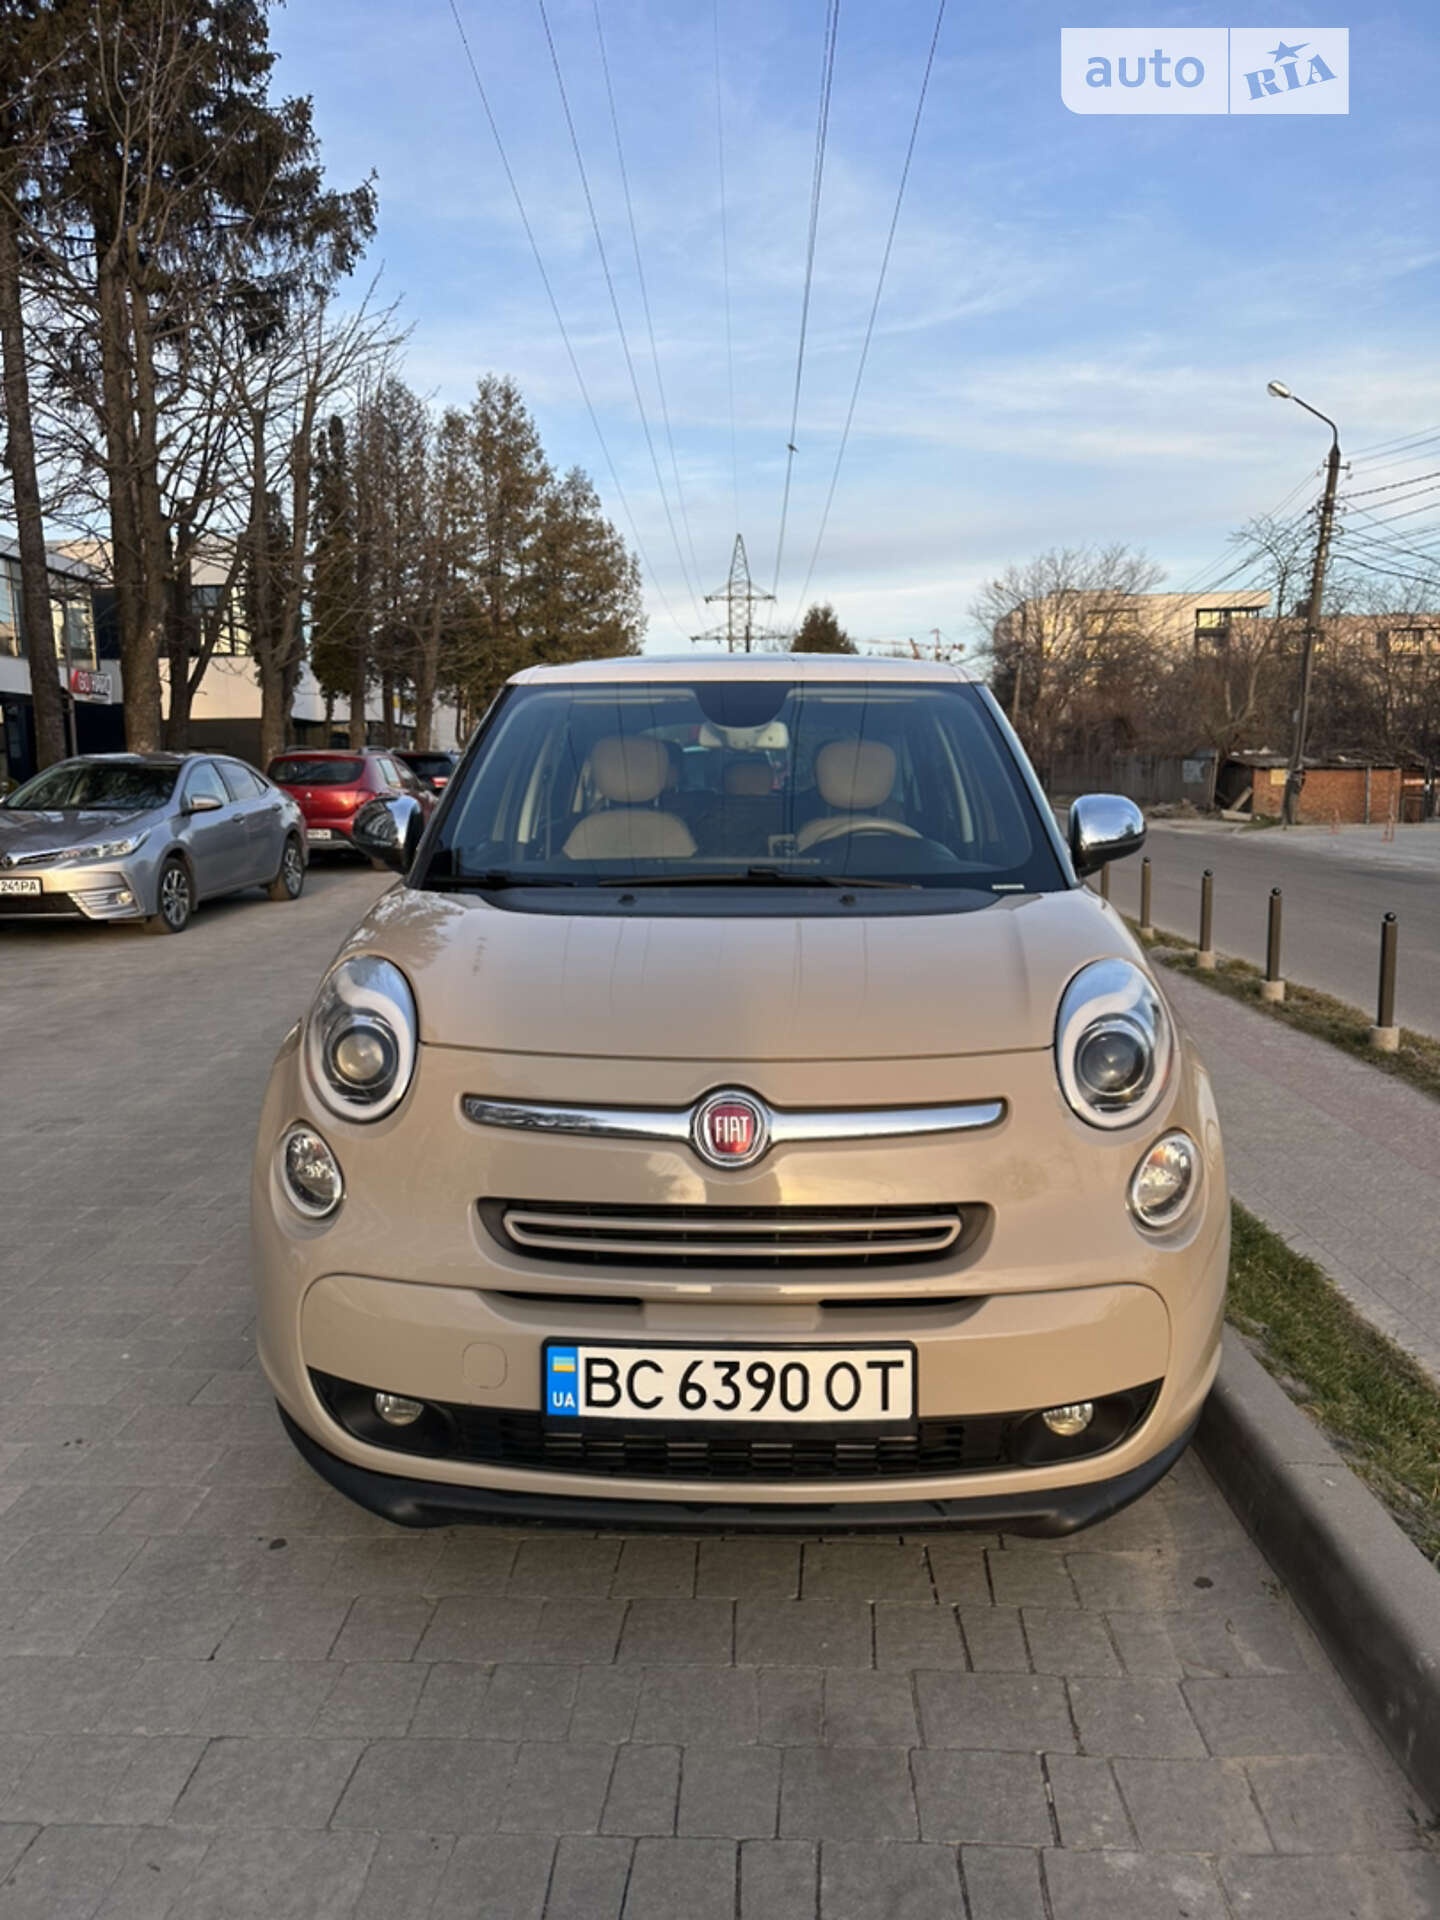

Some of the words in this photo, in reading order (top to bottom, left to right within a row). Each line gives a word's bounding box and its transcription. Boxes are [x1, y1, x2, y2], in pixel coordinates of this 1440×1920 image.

[715, 1116, 749, 1144] FIAT
[584, 1357, 664, 1410] BC
[678, 1360, 810, 1412] 6390
[825, 1360, 904, 1412] OT
[552, 1391, 576, 1408] UA
